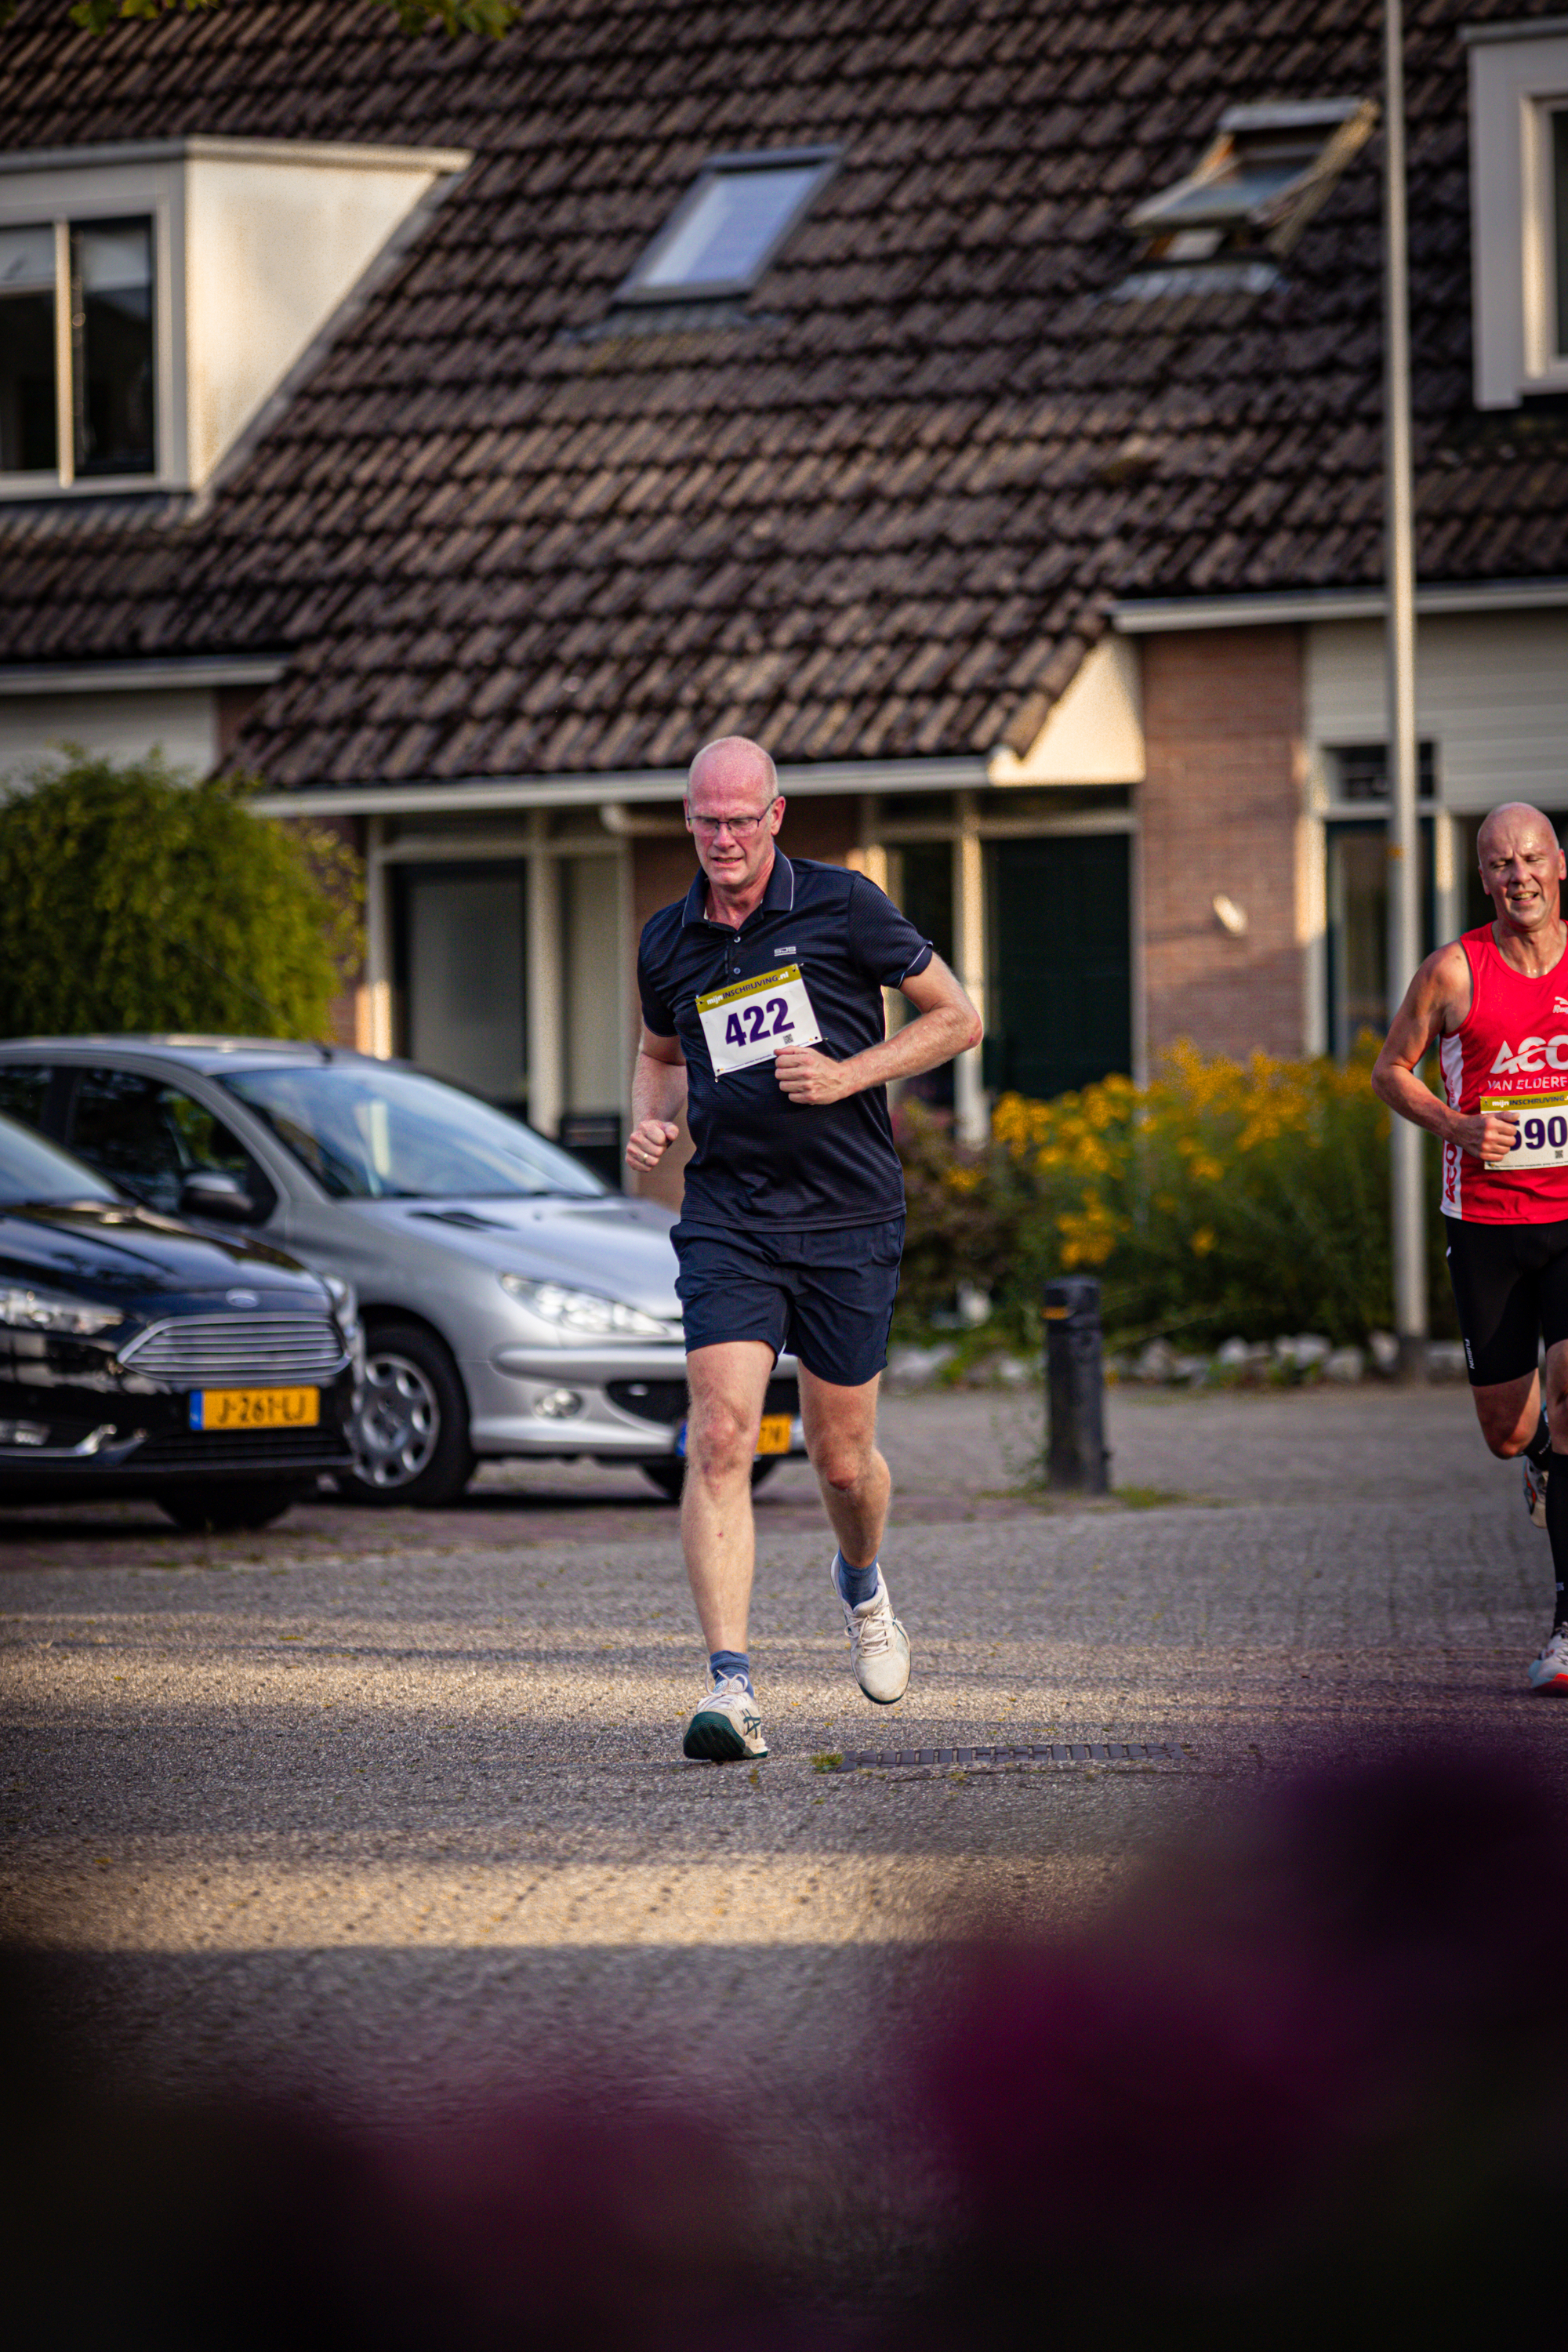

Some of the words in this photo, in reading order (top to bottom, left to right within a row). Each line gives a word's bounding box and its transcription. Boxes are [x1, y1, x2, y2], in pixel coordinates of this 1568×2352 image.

[706, 971, 789, 1005] mijnINSCHRIJVING.nl
[725, 997, 795, 1047] 422
[1487, 1080, 1513, 1091] VAN
[1491, 1095, 1568, 1108] mijnINSCHRIJVING.
[1464, 1338, 1475, 1370] FUSION
